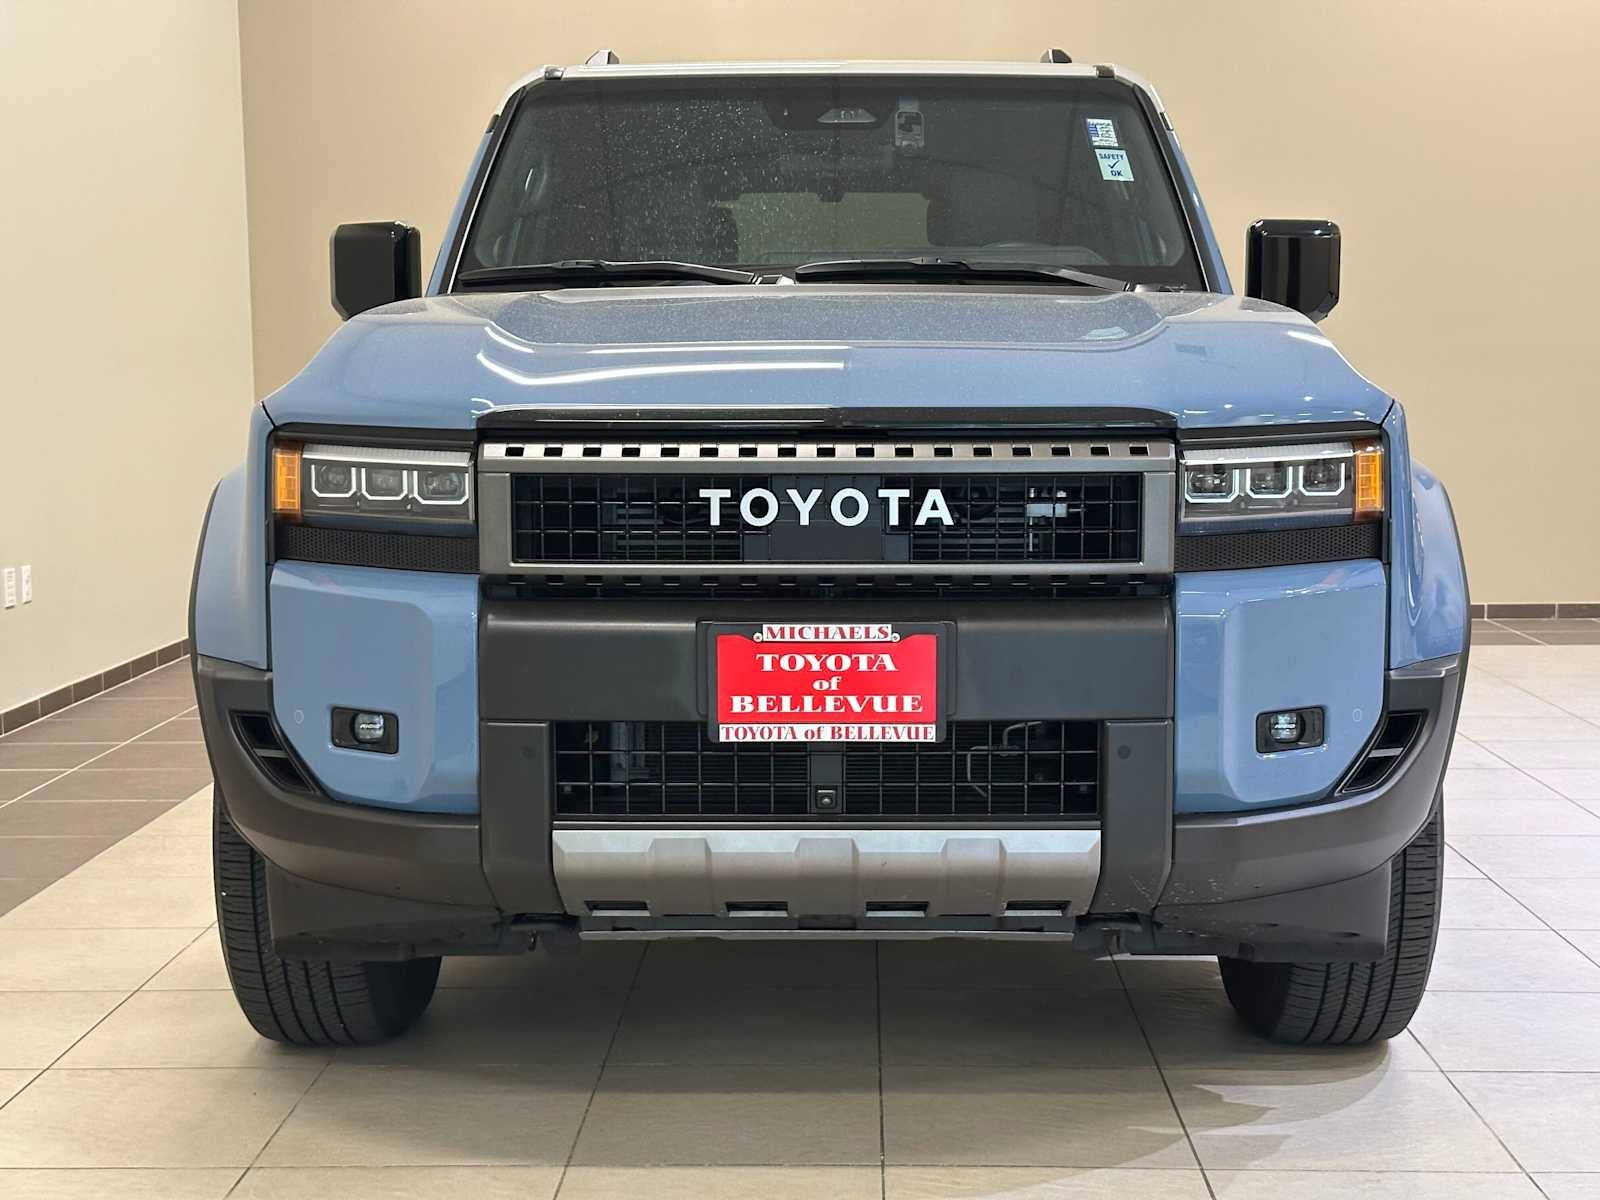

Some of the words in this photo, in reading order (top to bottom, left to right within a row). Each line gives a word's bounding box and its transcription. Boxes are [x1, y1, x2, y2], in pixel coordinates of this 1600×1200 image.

[699, 488, 955, 527] TOYOTA
[765, 626, 890, 640] MICHAELS
[756, 653, 898, 671] TOYOTA
[812, 676, 843, 691] of
[729, 695, 923, 713] BELLEVUE
[721, 726, 798, 740] TOYOTA
[804, 726, 825, 740] of
[830, 726, 935, 741] BELLEVUE
